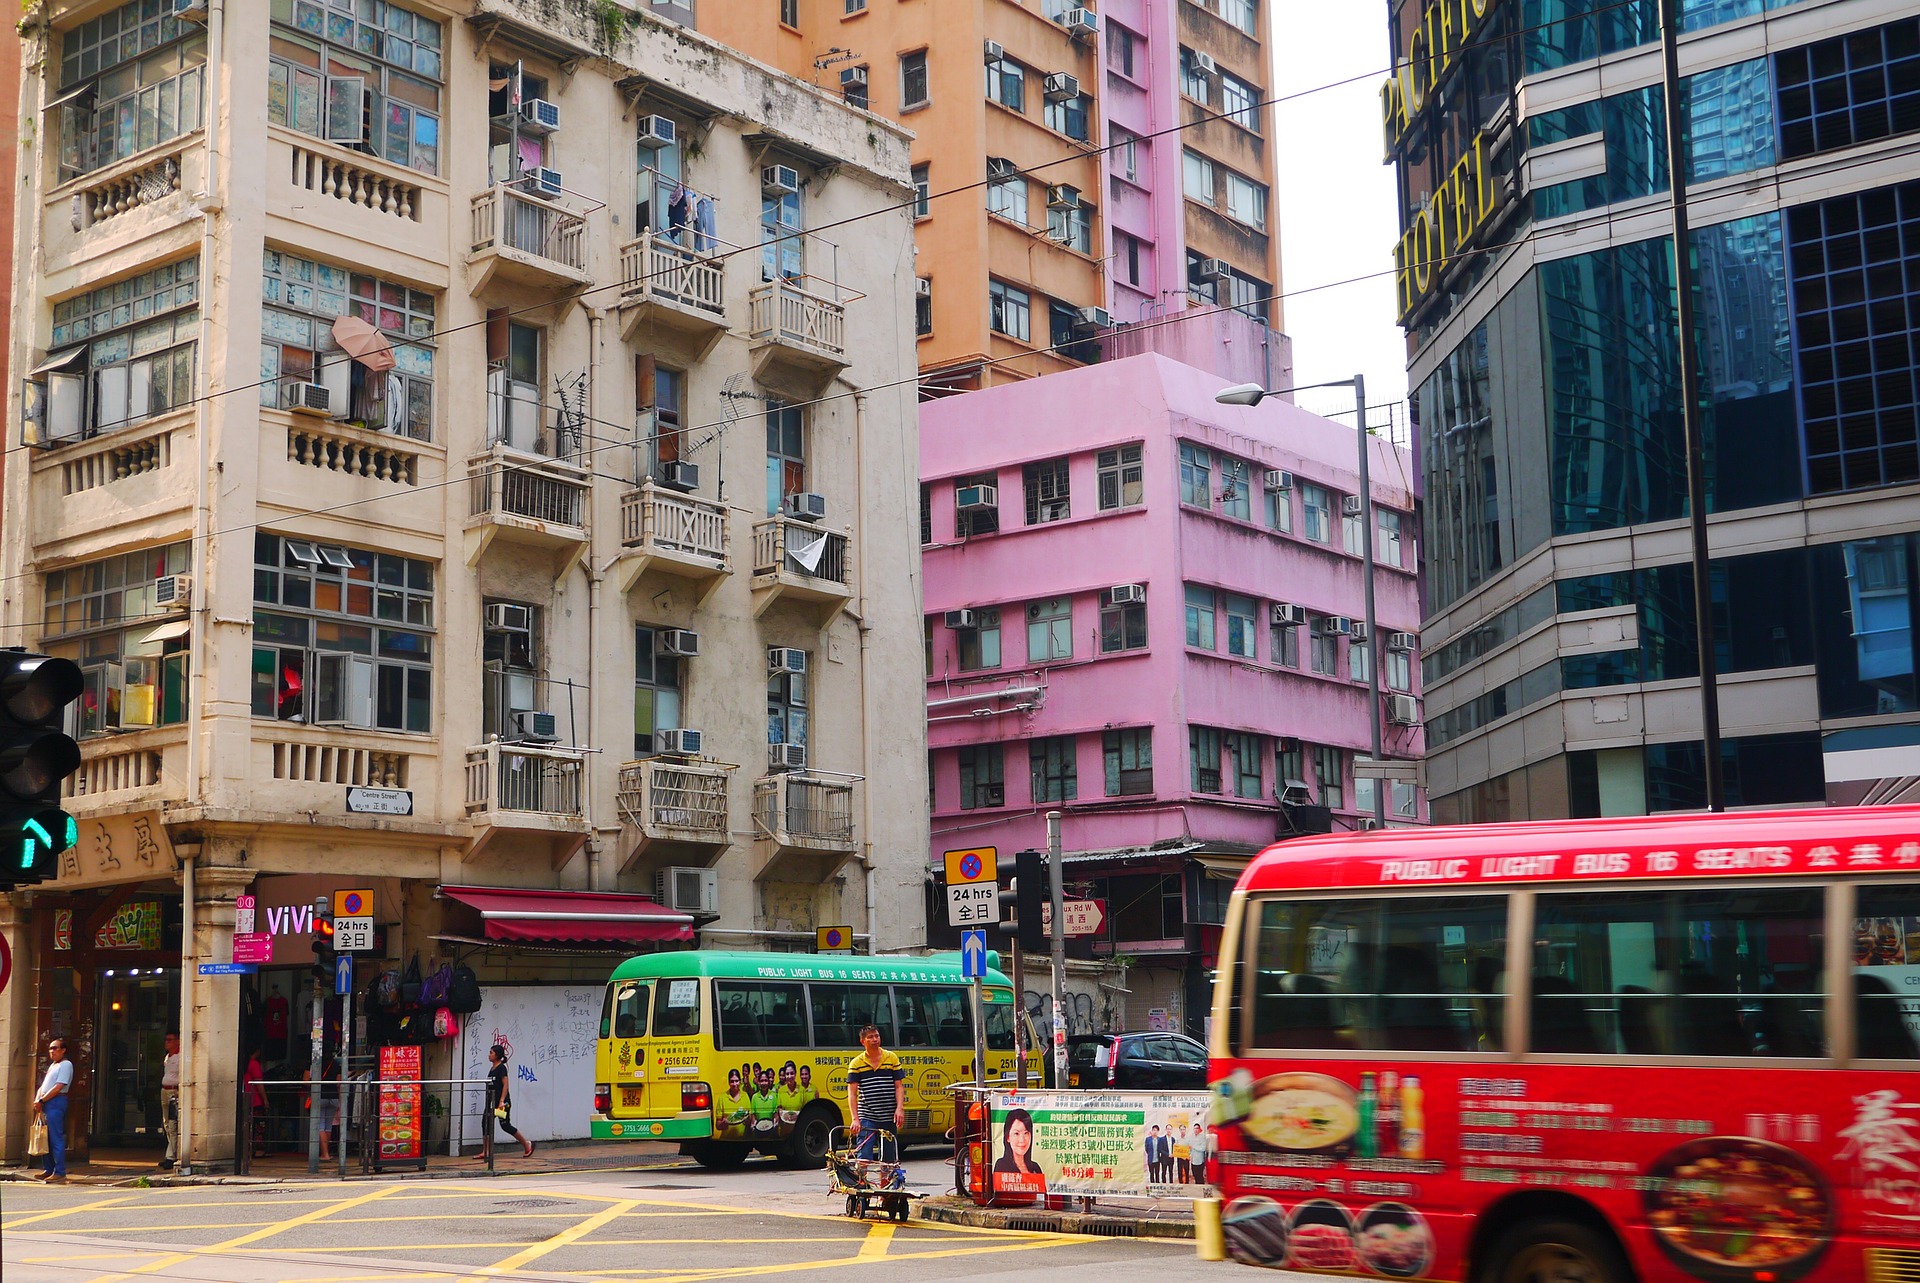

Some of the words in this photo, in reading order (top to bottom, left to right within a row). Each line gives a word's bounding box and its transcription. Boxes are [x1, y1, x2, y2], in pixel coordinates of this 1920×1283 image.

[1393, 130, 1498, 326] HOTEL
[361, 791, 379, 799] Centre
[381, 792, 397, 800] Street
[373, 802, 388, 811] 正街
[1379, 858, 1469, 881] PUBLIC
[1480, 854, 1560, 878] LIGHT
[1573, 852, 1631, 874] BUS
[1644, 851, 1679, 872] 16
[1693, 846, 1793, 870] SEATS
[953, 889, 970, 901] 24
[973, 888, 992, 900] hrs
[958, 903, 989, 922] 全日
[1074, 904, 1083, 912] Rd
[1085, 903, 1092, 912] W
[337, 921, 350, 931] 24
[352, 920, 369, 931] hrs
[340, 933, 366, 948] 全日
[758, 967, 786, 977] PUBLIC
[790, 968, 813, 978] LIGHT
[818, 969, 834, 979] BUS
[852, 970, 877, 980] SEATS
[664, 1057, 681, 1066] 2516
[682, 1056, 699, 1065] 6277
[623, 1124, 636, 1132] 2751
[1041, 1126, 1134, 1139] 關注13號小巴服務質素
[1041, 1139, 1134, 1152] 強烈要求13號小巴班次
[1055, 1153, 1119, 1166] 於繁忙時間維持
[1062, 1166, 1113, 1179] 每8分鐘一班
